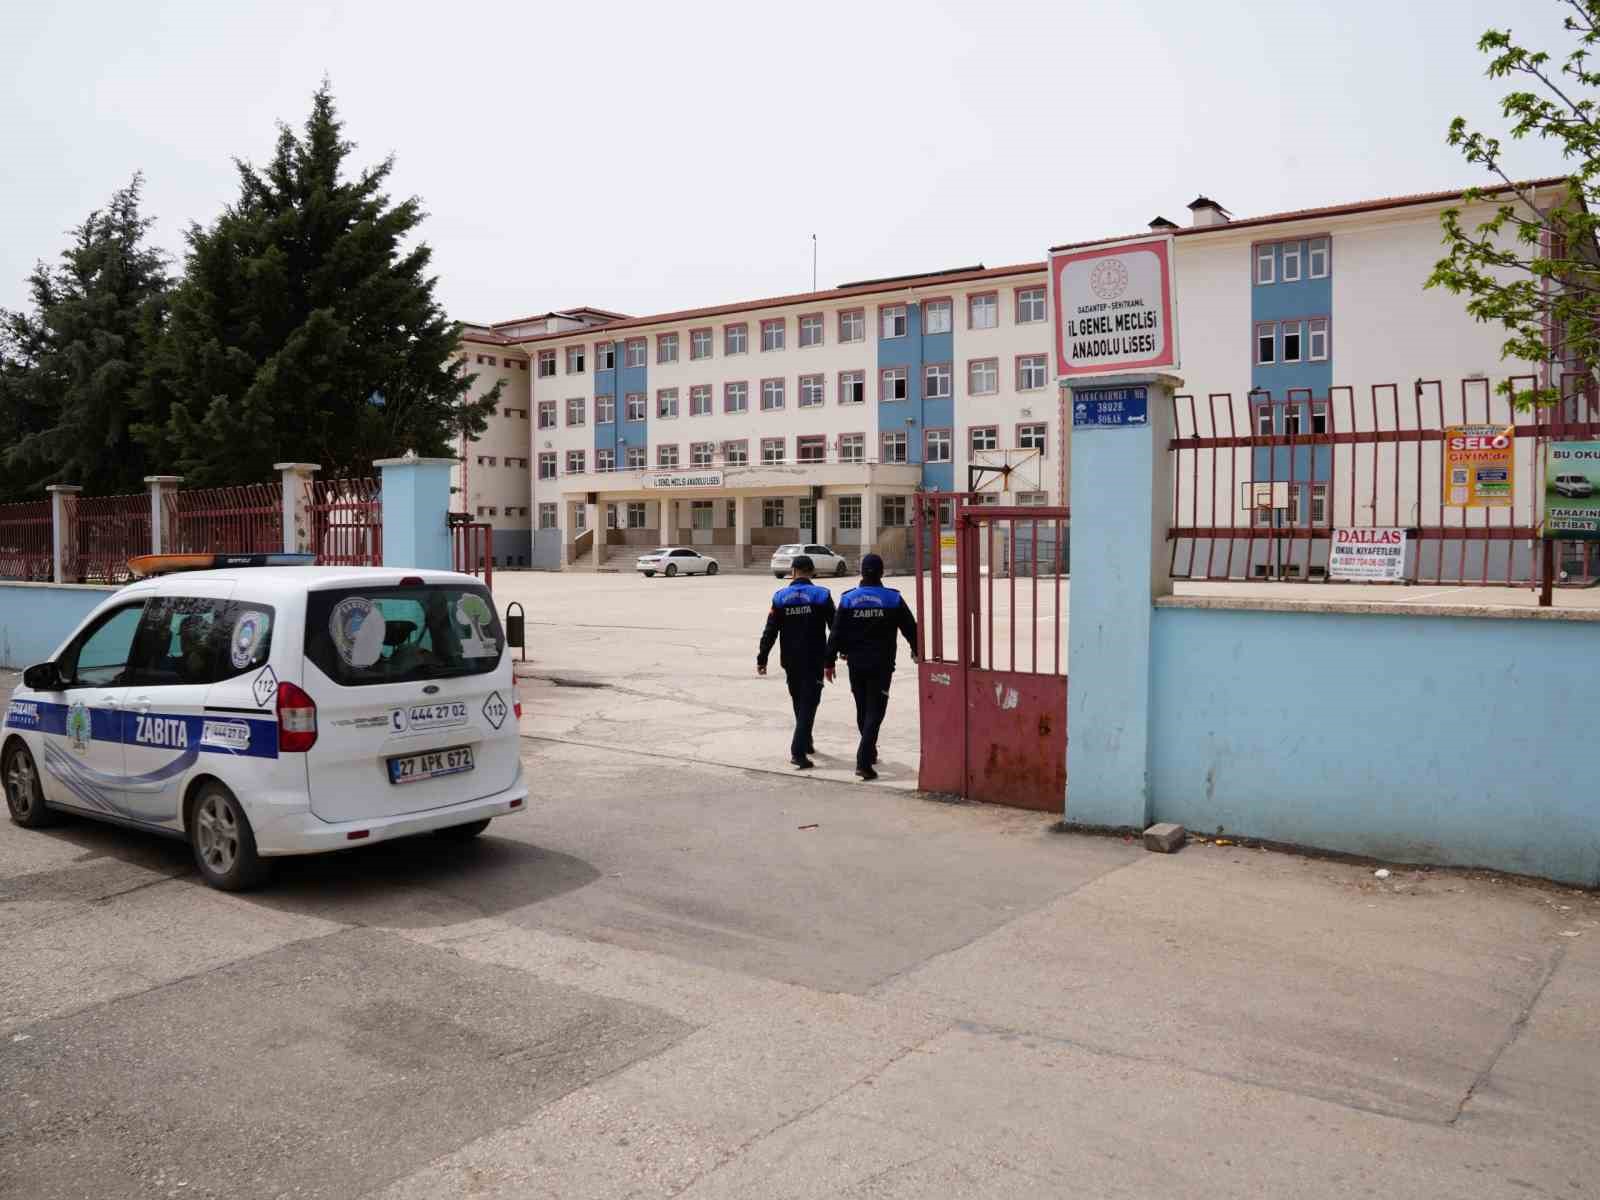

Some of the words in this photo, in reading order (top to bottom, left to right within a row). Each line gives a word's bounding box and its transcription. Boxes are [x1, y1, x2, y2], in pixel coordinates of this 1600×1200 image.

[1079, 316, 1113, 336] GENEL
[1115, 310, 1157, 331] MECLİSİ
[1072, 338, 1120, 359] ANADOLU
[1122, 334, 1155, 354] LİSESİ
[1451, 436, 1509, 449] SELO
[1553, 450, 1570, 459] BU
[1337, 530, 1401, 544] DALLAS
[1335, 546, 1353, 555] OKUL
[785, 605, 812, 616] ZABITA
[853, 608, 885, 618] ZABITA
[259, 679, 274, 693] 112
[411, 708, 433, 721] 444
[435, 706, 449, 719] 27
[452, 704, 466, 717] 02
[488, 703, 503, 717] 112
[136, 716, 188, 748] ZABITA
[400, 758, 415, 776] 27
[421, 752, 443, 772] APK
[447, 749, 470, 768] 672
